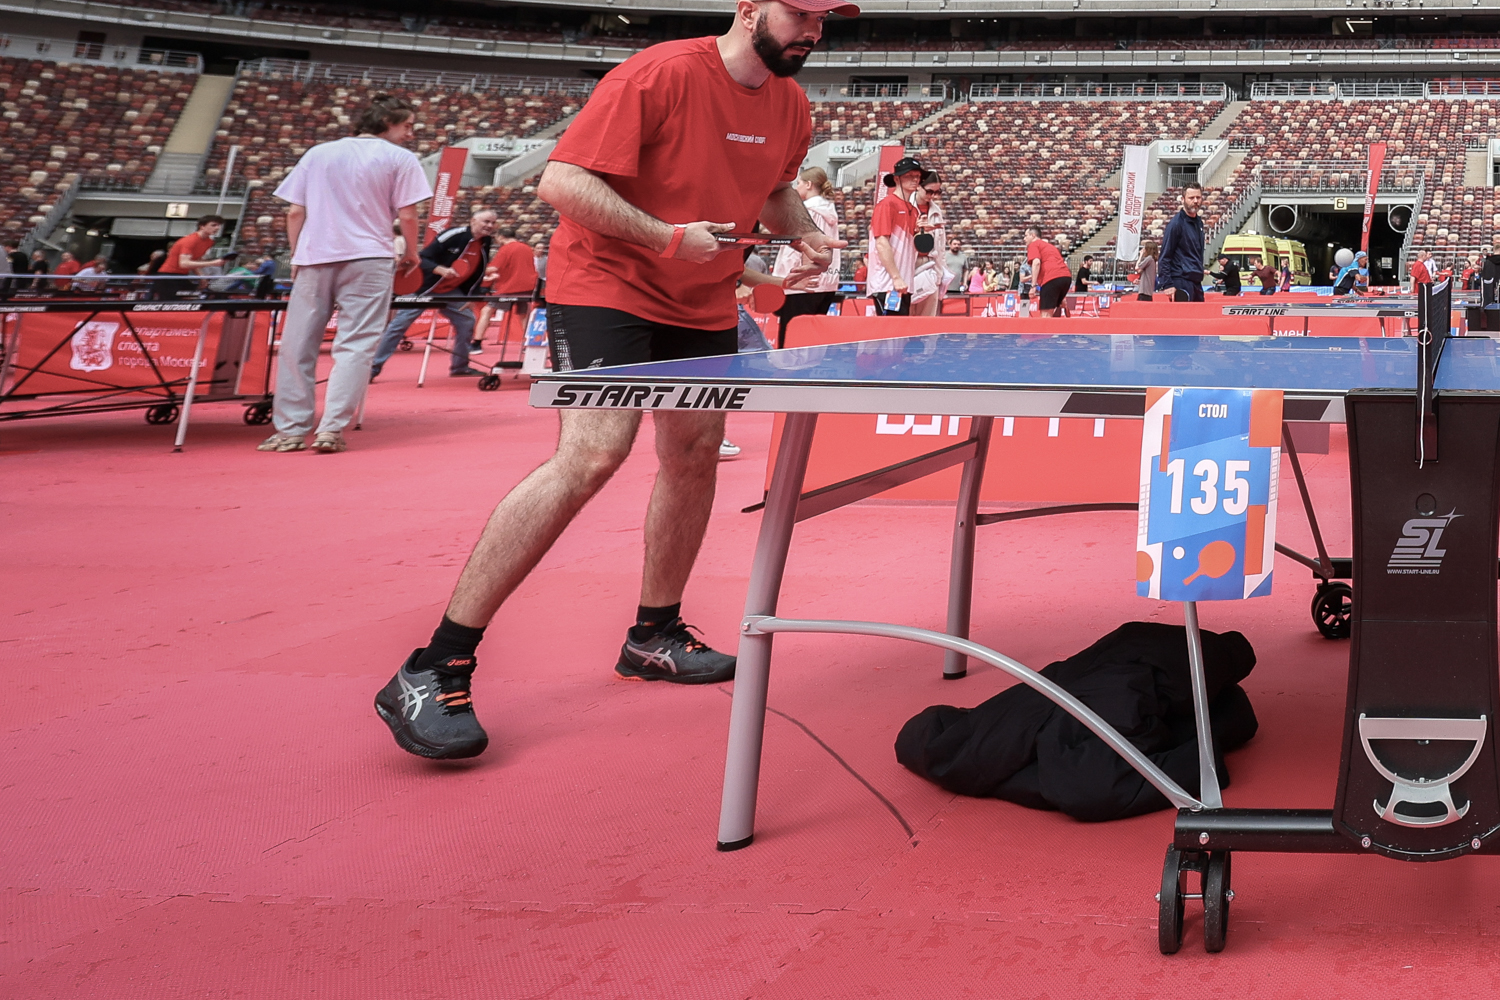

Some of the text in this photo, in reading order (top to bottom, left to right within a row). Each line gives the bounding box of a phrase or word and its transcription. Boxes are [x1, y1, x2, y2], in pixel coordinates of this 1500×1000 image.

[486, 143, 505, 151] 156
[1170, 144, 1187, 153] 152
[1124, 171, 1136, 216] МОСКОВСКИЙ
[170, 204, 179, 216] 1
[1132, 195, 1142, 217] СПОРТ
[1337, 198, 1345, 208] 6
[1228, 308, 1286, 316] START LINE
[551, 384, 752, 409] START LINE
[1198, 403, 1228, 419] СТОЛ
[1166, 458, 1251, 516] 135
[1393, 518, 1447, 558] SL
